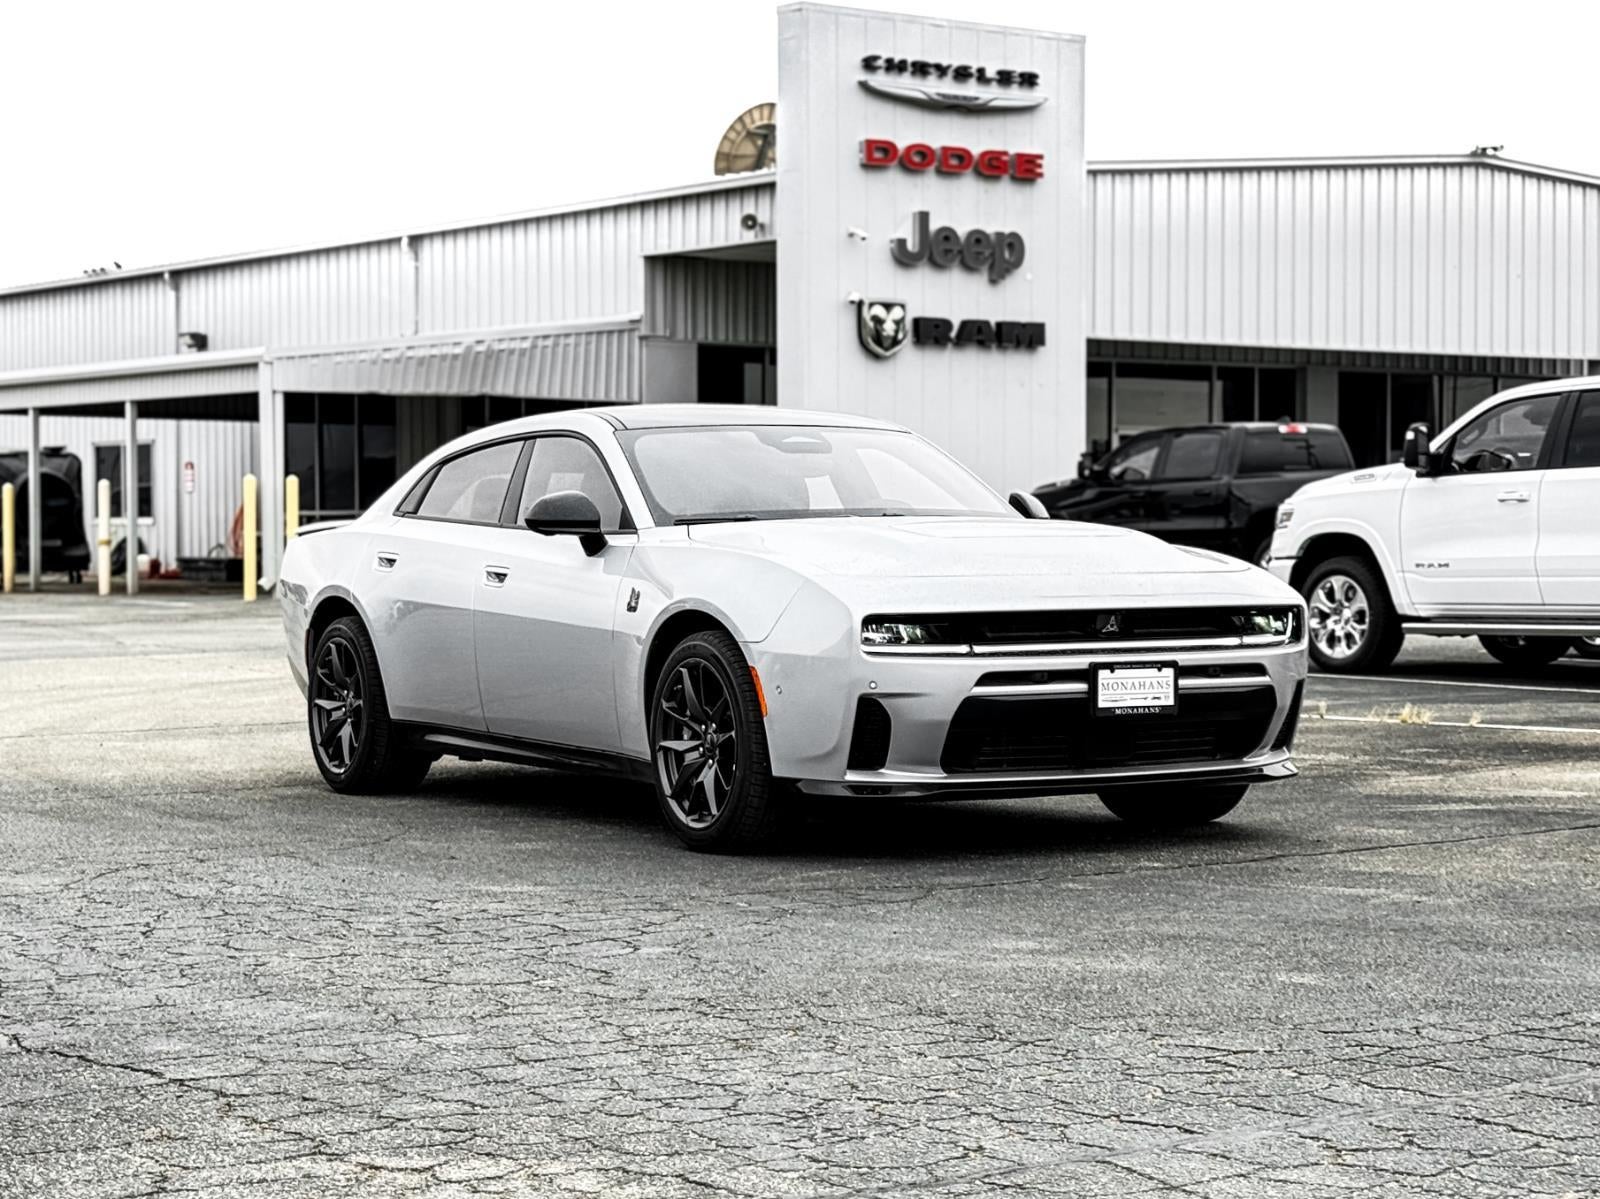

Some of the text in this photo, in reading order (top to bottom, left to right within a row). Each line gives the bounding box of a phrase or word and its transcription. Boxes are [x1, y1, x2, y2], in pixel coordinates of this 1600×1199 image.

[861, 55, 1040, 87] CHRYSLER
[861, 138, 1044, 179] DODGE
[890, 210, 1025, 283] Jeep
[912, 317, 1046, 347] RAM
[1101, 680, 1171, 691] MONAHANS
